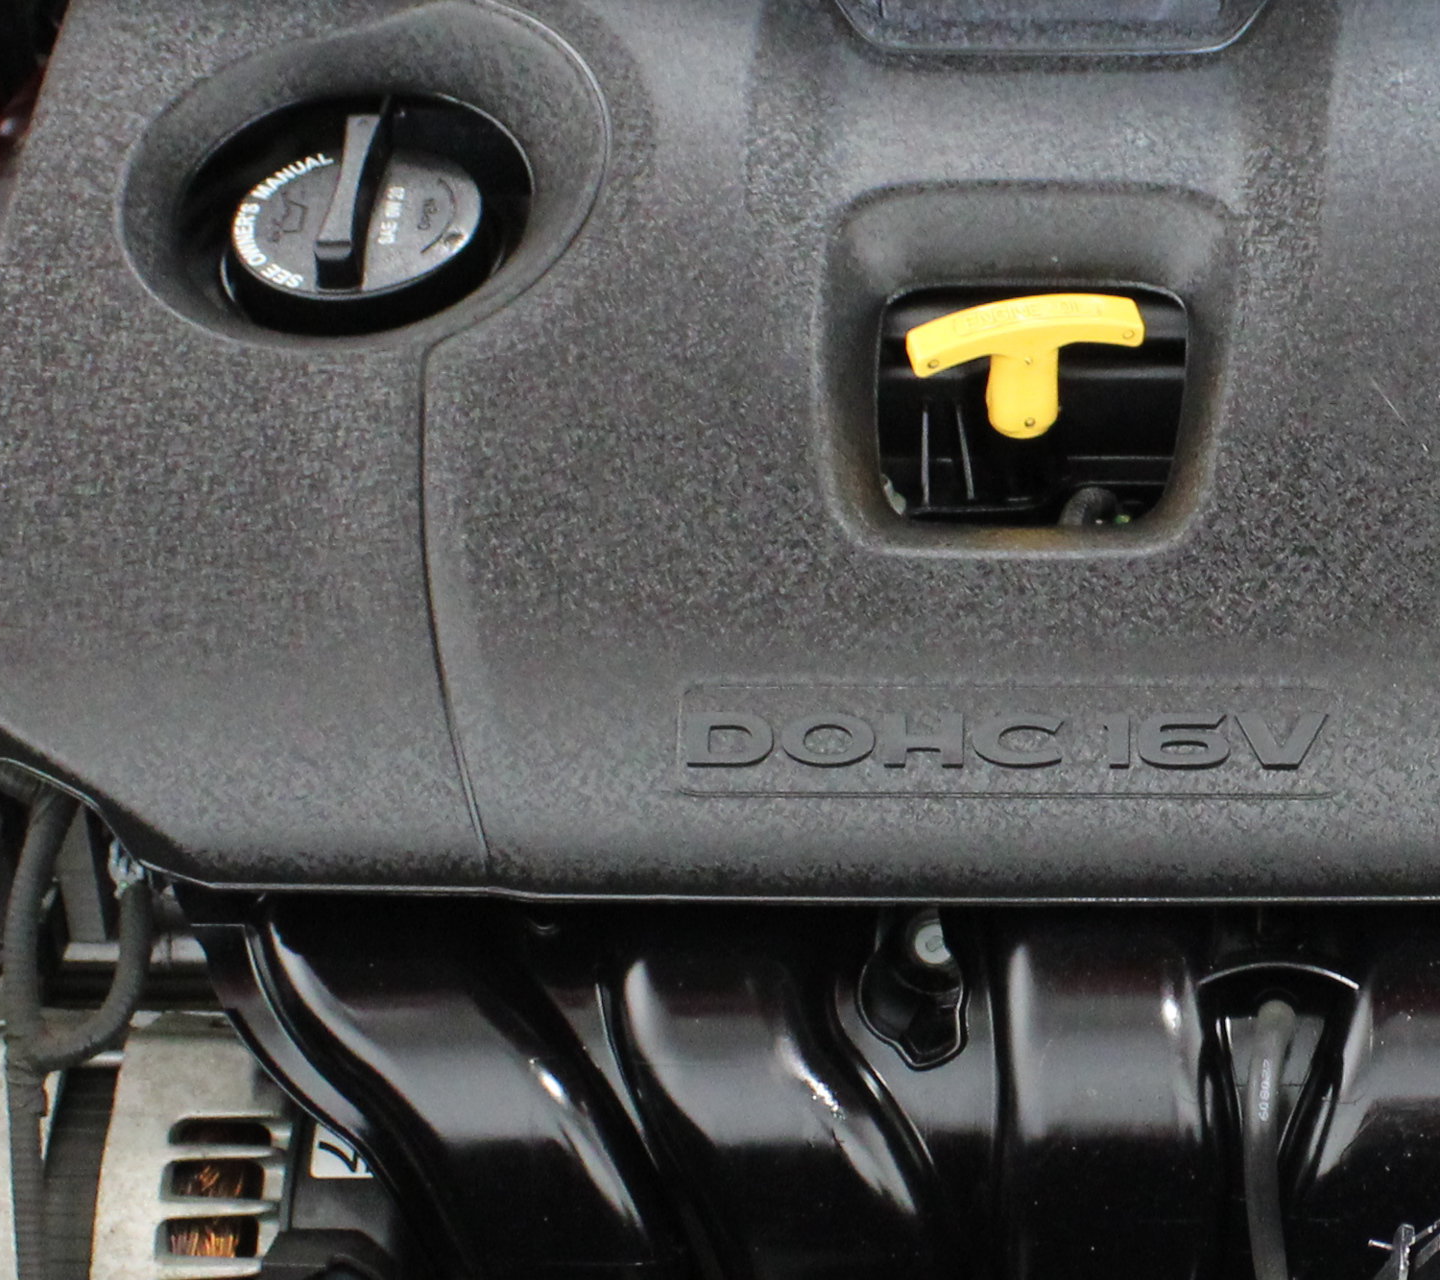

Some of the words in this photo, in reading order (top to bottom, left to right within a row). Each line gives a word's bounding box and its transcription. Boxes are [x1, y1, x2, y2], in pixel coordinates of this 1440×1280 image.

[250, 152, 335, 201] MANUAL
[260, 262, 304, 288] SEE
[686, 713, 1065, 768] DOHC
[1101, 713, 1329, 770] 16V
